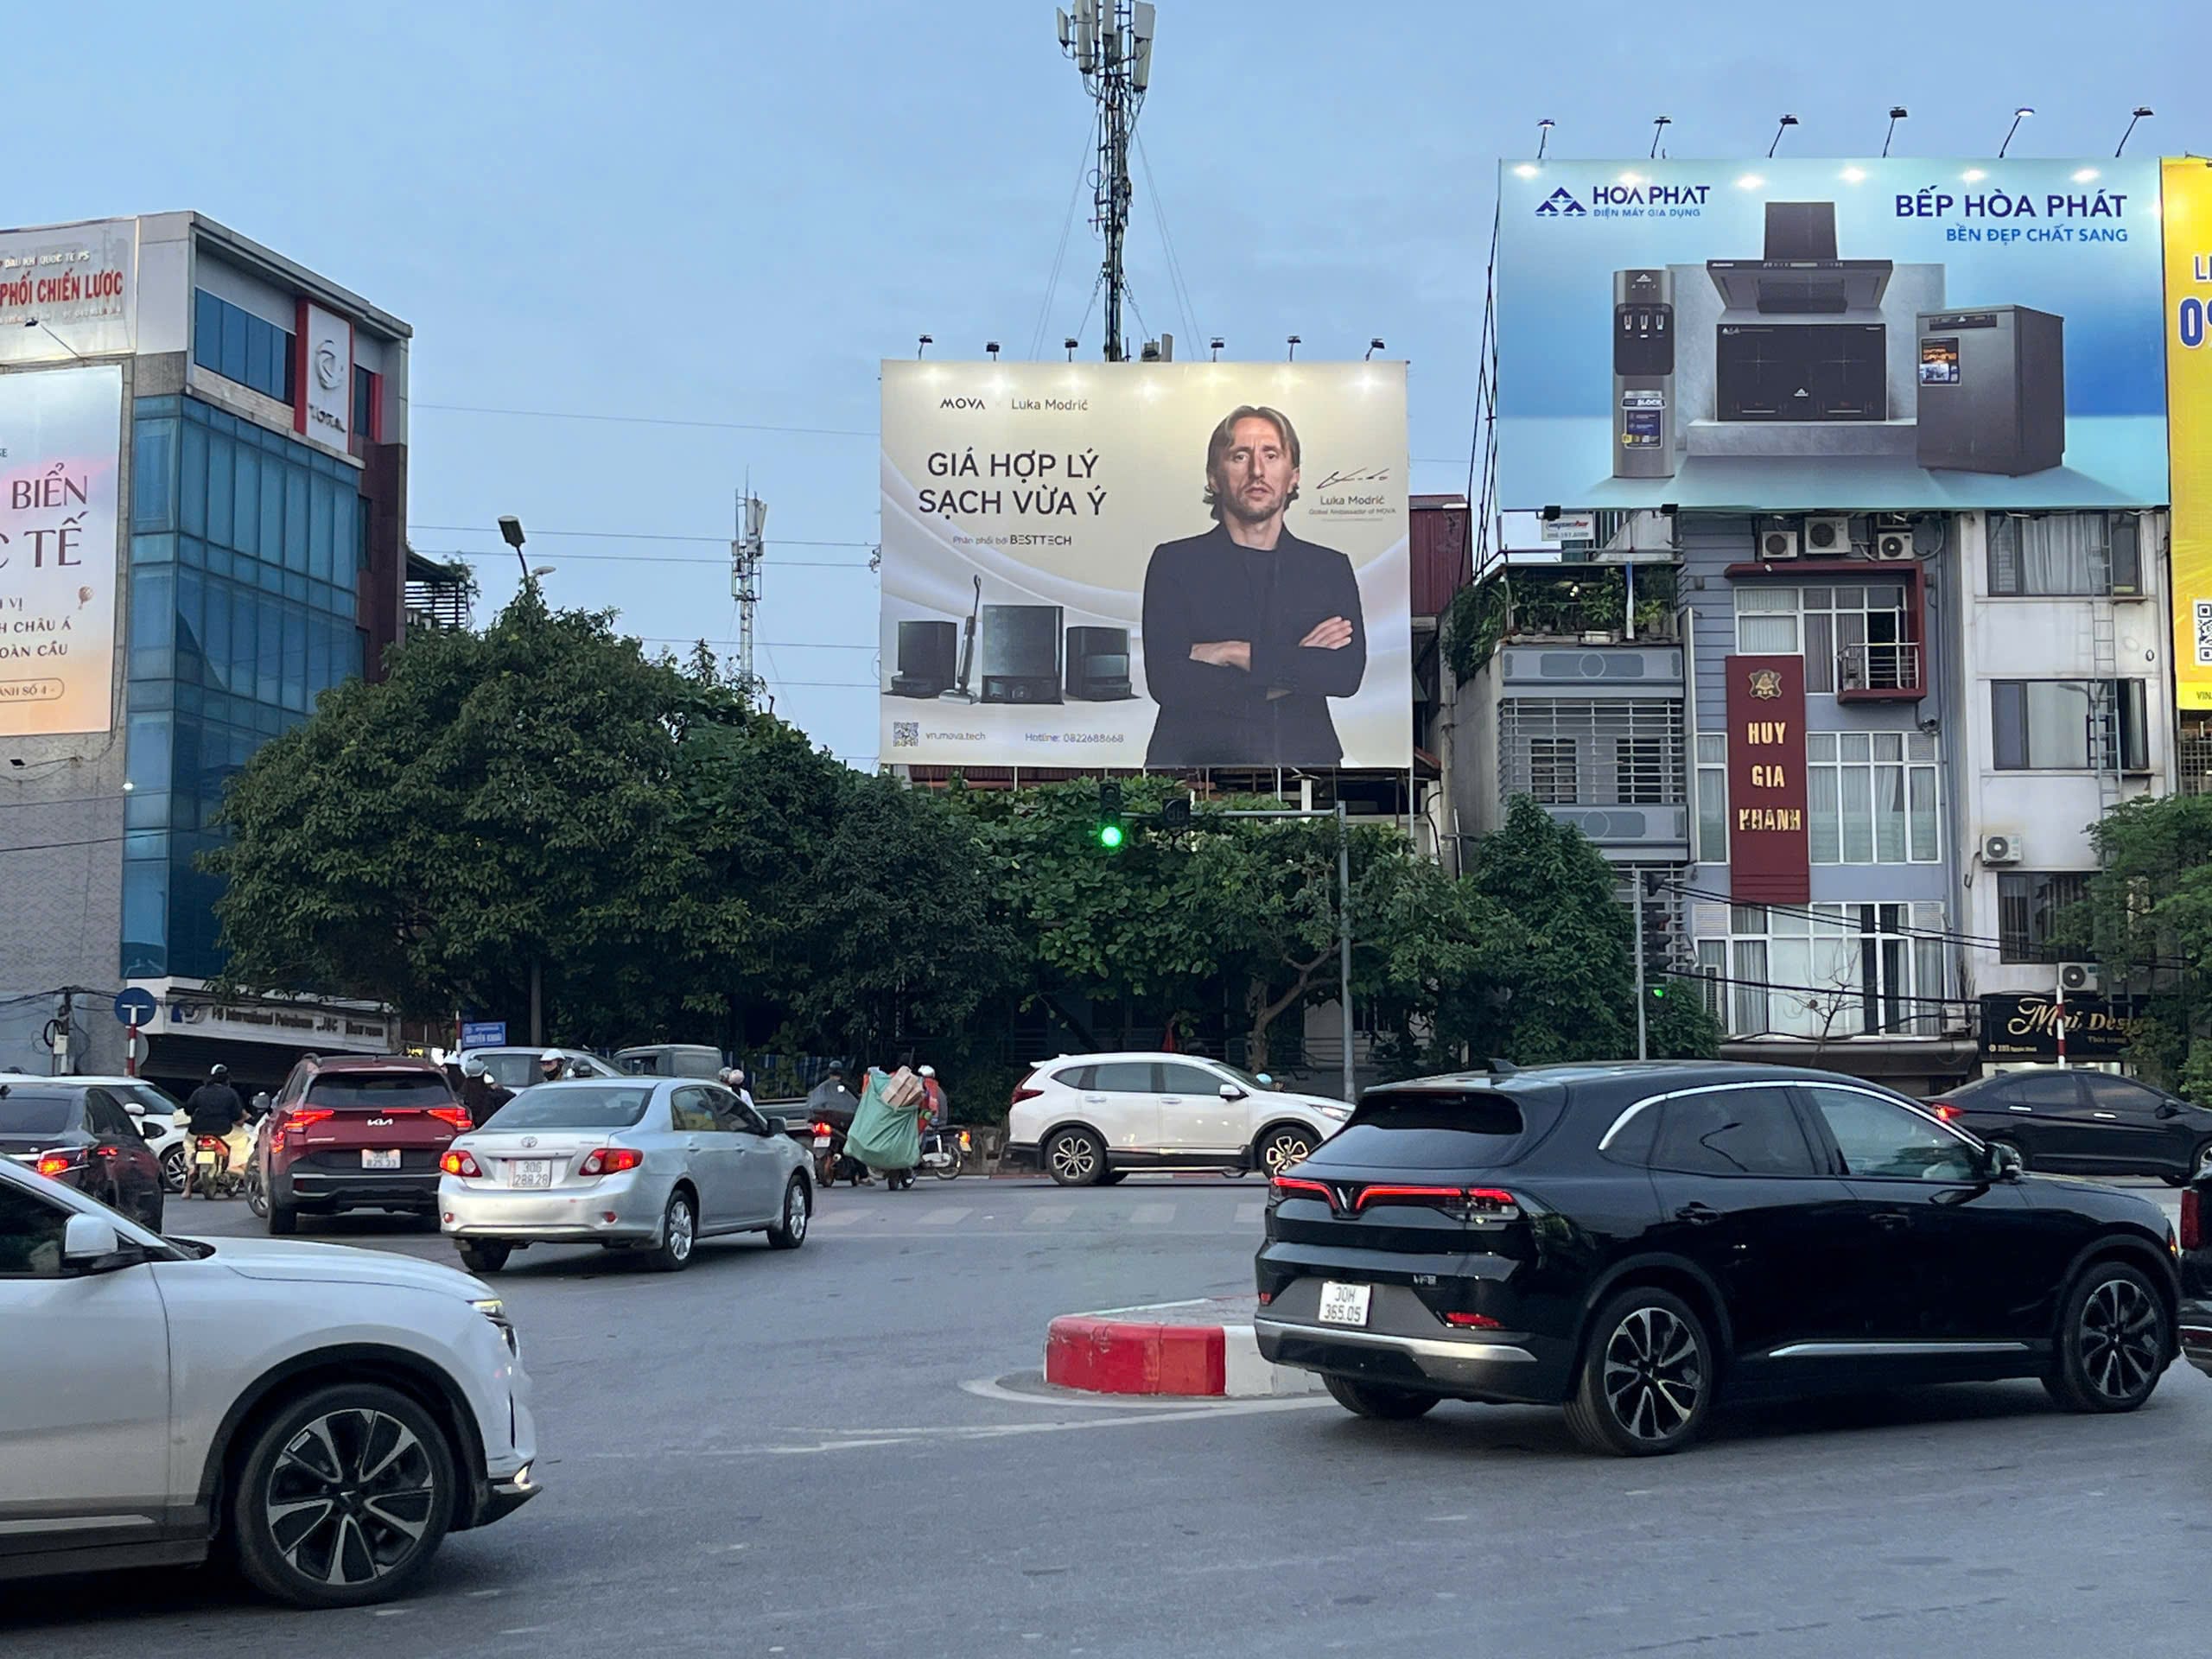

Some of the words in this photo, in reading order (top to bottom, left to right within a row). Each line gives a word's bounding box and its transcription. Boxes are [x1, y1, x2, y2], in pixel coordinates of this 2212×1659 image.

[1649, 185, 1711, 205] PHÁT
[1895, 185, 1954, 217] BẾP
[1965, 188, 2037, 217] HÒA
[2047, 188, 2127, 217] PHÁT
[1623, 207, 1643, 217] MÁY
[1669, 209, 1700, 219] DỤNG
[1946, 222, 1981, 242] BỀN
[1987, 228, 2021, 245] ĐẸP
[2026, 224, 2074, 242] CHẤT
[2078, 228, 2128, 242] SANG
[37, 267, 80, 303] CHIẾN
[85, 268, 124, 302] LƯỢC
[940, 397, 986, 410] MOVA
[1011, 398, 1041, 410] Luka
[1046, 399, 1089, 411] Modrić
[927, 446, 980, 477] GIÁ
[990, 449, 1056, 484] HỢP
[1067, 448, 1099, 478] LÝ
[12, 462, 88, 510] BIỂN
[918, 489, 1001, 520] SẠCH
[1013, 484, 1077, 515] VỪA
[1087, 485, 1107, 516] Ý
[1319, 495, 1345, 505] Luka
[23, 511, 89, 568] TẾ
[1009, 534, 1072, 546] BESTTECH
[10, 597, 22, 612] VỊ
[14, 617, 56, 633] CHÂU
[61, 615, 72, 631] Á
[1025, 732, 1061, 743] Hotline:
[1747, 722, 1786, 745] HUY
[1751, 765, 1785, 788] GIA
[1324, 1304, 1362, 1323] 365.05
